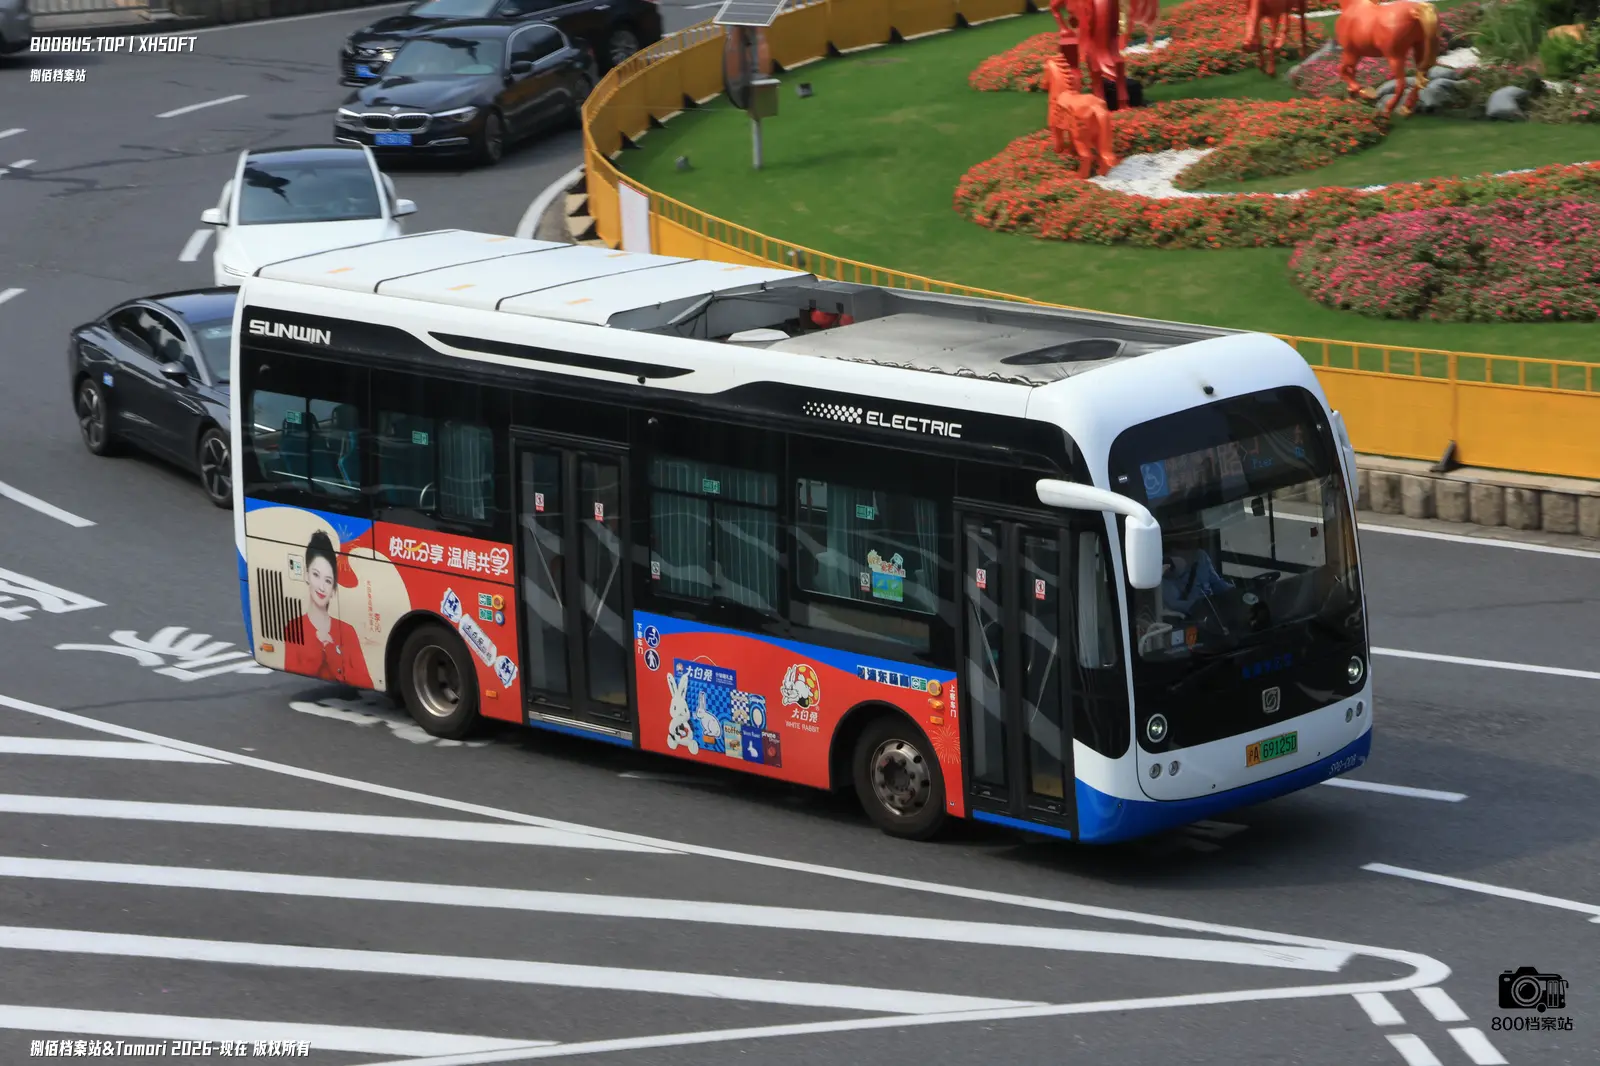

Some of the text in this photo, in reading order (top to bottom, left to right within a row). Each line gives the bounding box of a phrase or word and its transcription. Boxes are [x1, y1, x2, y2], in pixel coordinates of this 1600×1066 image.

[249, 319, 331, 345] SUNWIN
[866, 411, 962, 438] ELECTRIC
[389, 536, 510, 576] 快乐分享 温情共享
[686, 665, 713, 682] 大白兔
[785, 720, 801, 730] WHITE
[791, 708, 818, 723] 大白兔
